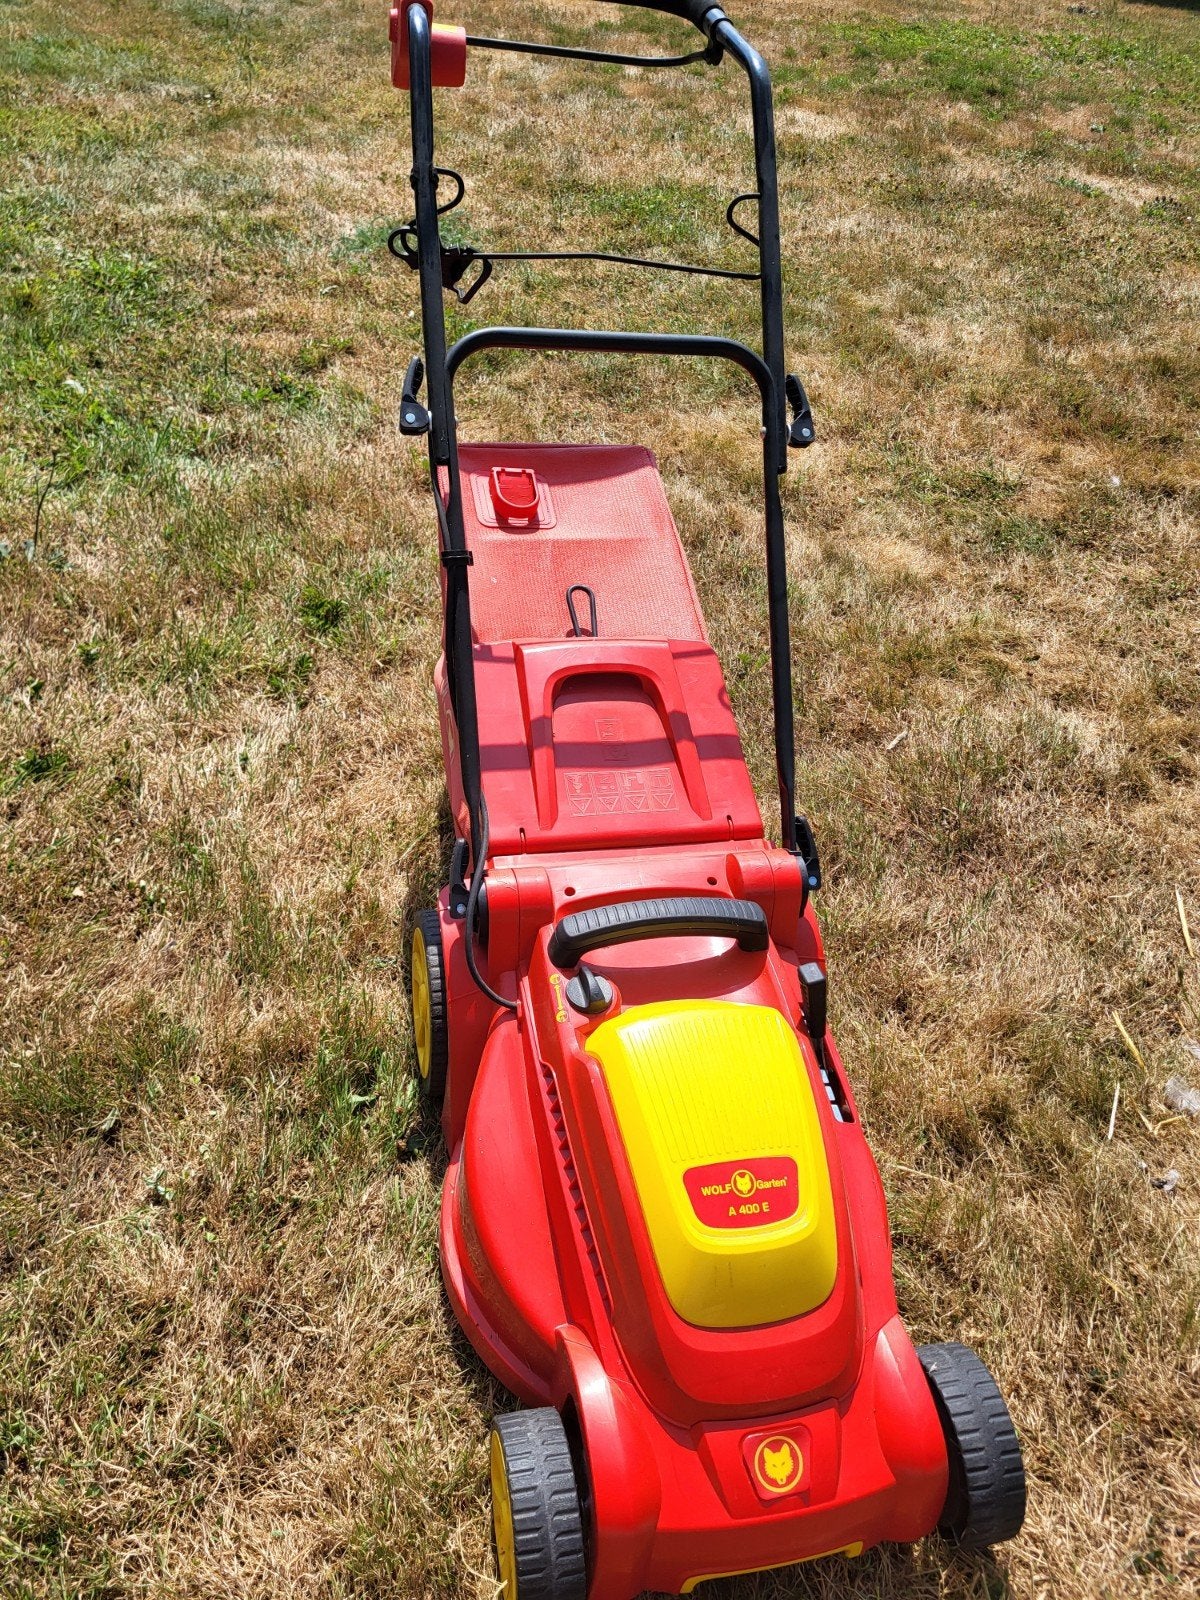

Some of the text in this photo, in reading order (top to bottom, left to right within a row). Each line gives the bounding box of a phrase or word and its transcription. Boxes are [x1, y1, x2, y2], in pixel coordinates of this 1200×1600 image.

[701, 1178, 787, 1196] WOLF Garten
[728, 1202, 770, 1217] A 400 E
